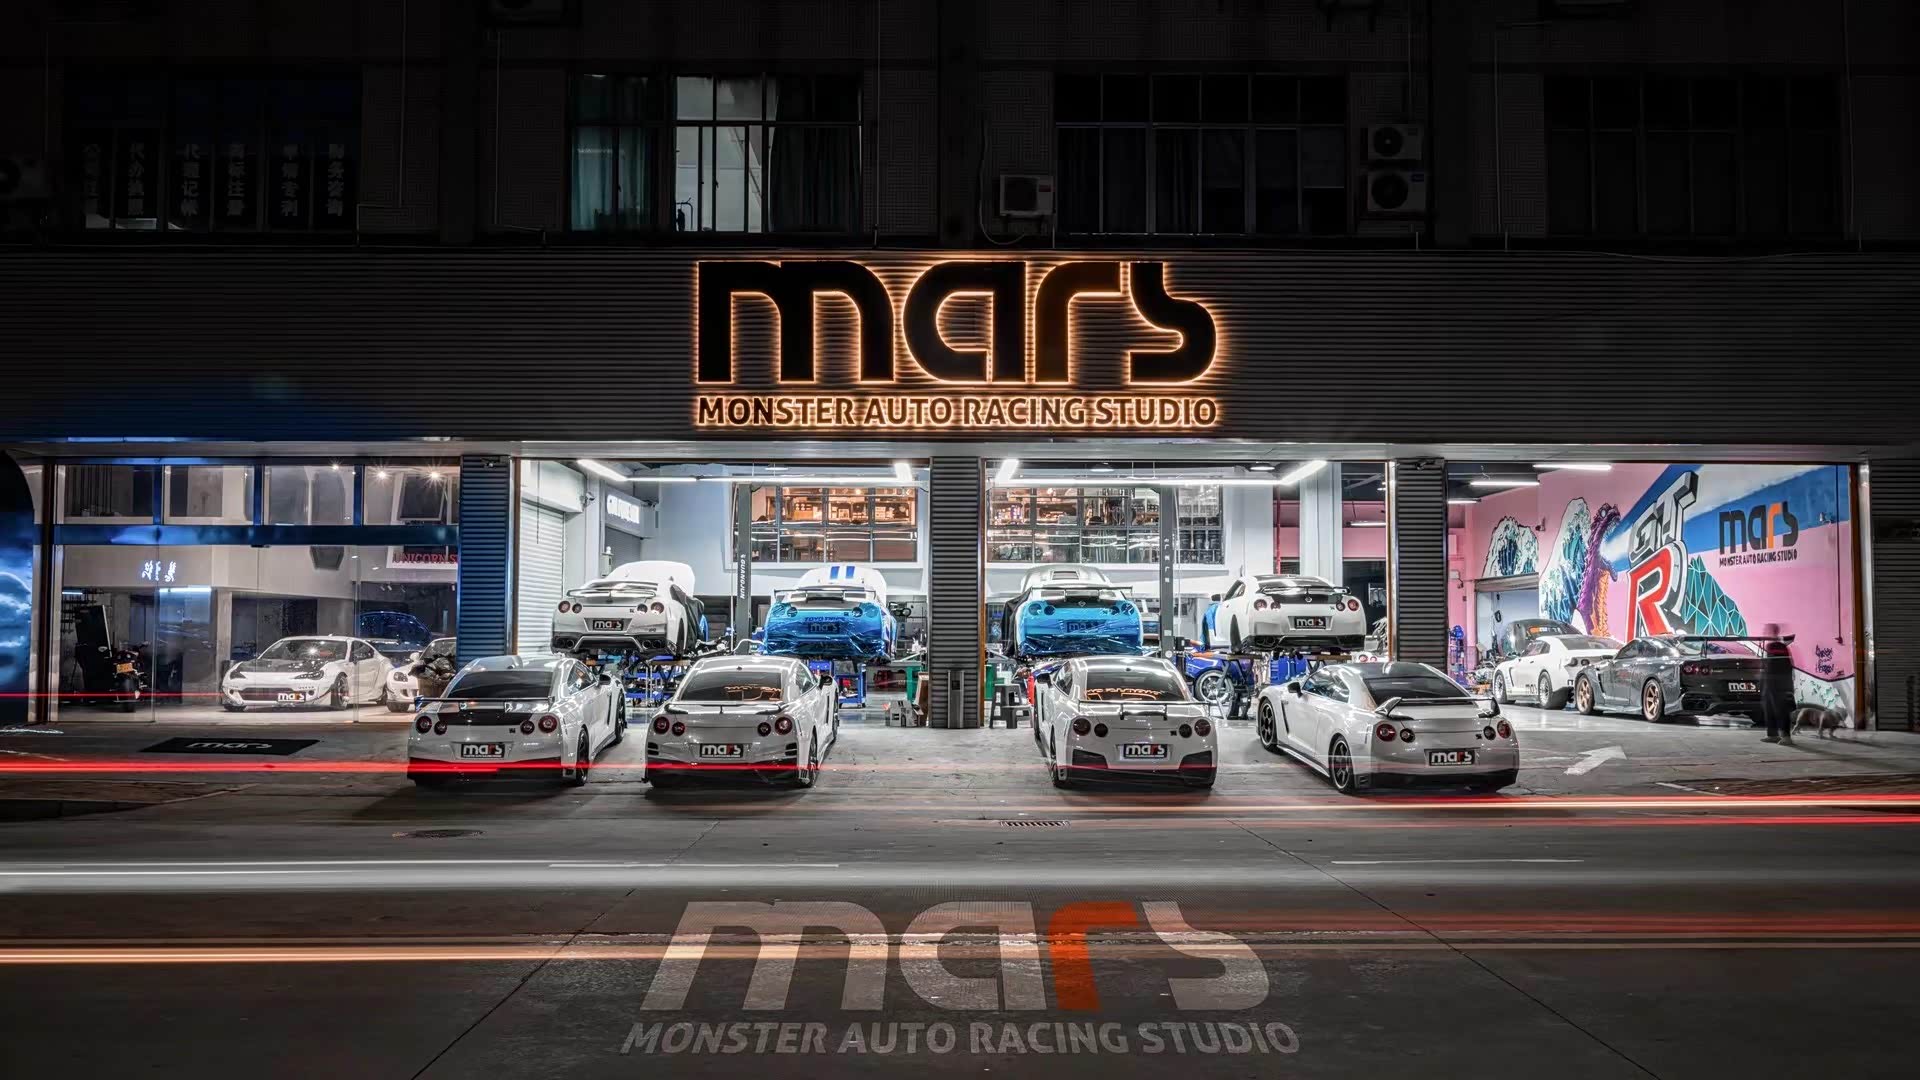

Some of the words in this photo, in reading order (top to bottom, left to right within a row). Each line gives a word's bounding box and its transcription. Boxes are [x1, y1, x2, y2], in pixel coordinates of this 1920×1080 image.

[697, 261, 1217, 384] mars
[698, 398, 856, 425] MONSTER
[864, 398, 953, 425] AUTO
[963, 398, 1085, 425] RACING
[1095, 398, 1217, 426] STUDIO
[1719, 501, 1799, 555] mars
[1720, 554, 1742, 567] MONSTER
[1743, 553, 1756, 565] AUTO
[1757, 550, 1777, 564] RACING
[1777, 548, 1798, 561] STUDIO
[463, 744, 502, 755] mars
[702, 744, 741, 755] mars
[1126, 744, 1165, 755] mars
[1431, 751, 1472, 762] mars
[640, 901, 1269, 1011] mars
[620, 1022, 828, 1055] MONSTER
[838, 1022, 955, 1055] AUTO
[969, 1022, 1128, 1055] RACING
[1138, 1022, 1301, 1056] STUDIO
